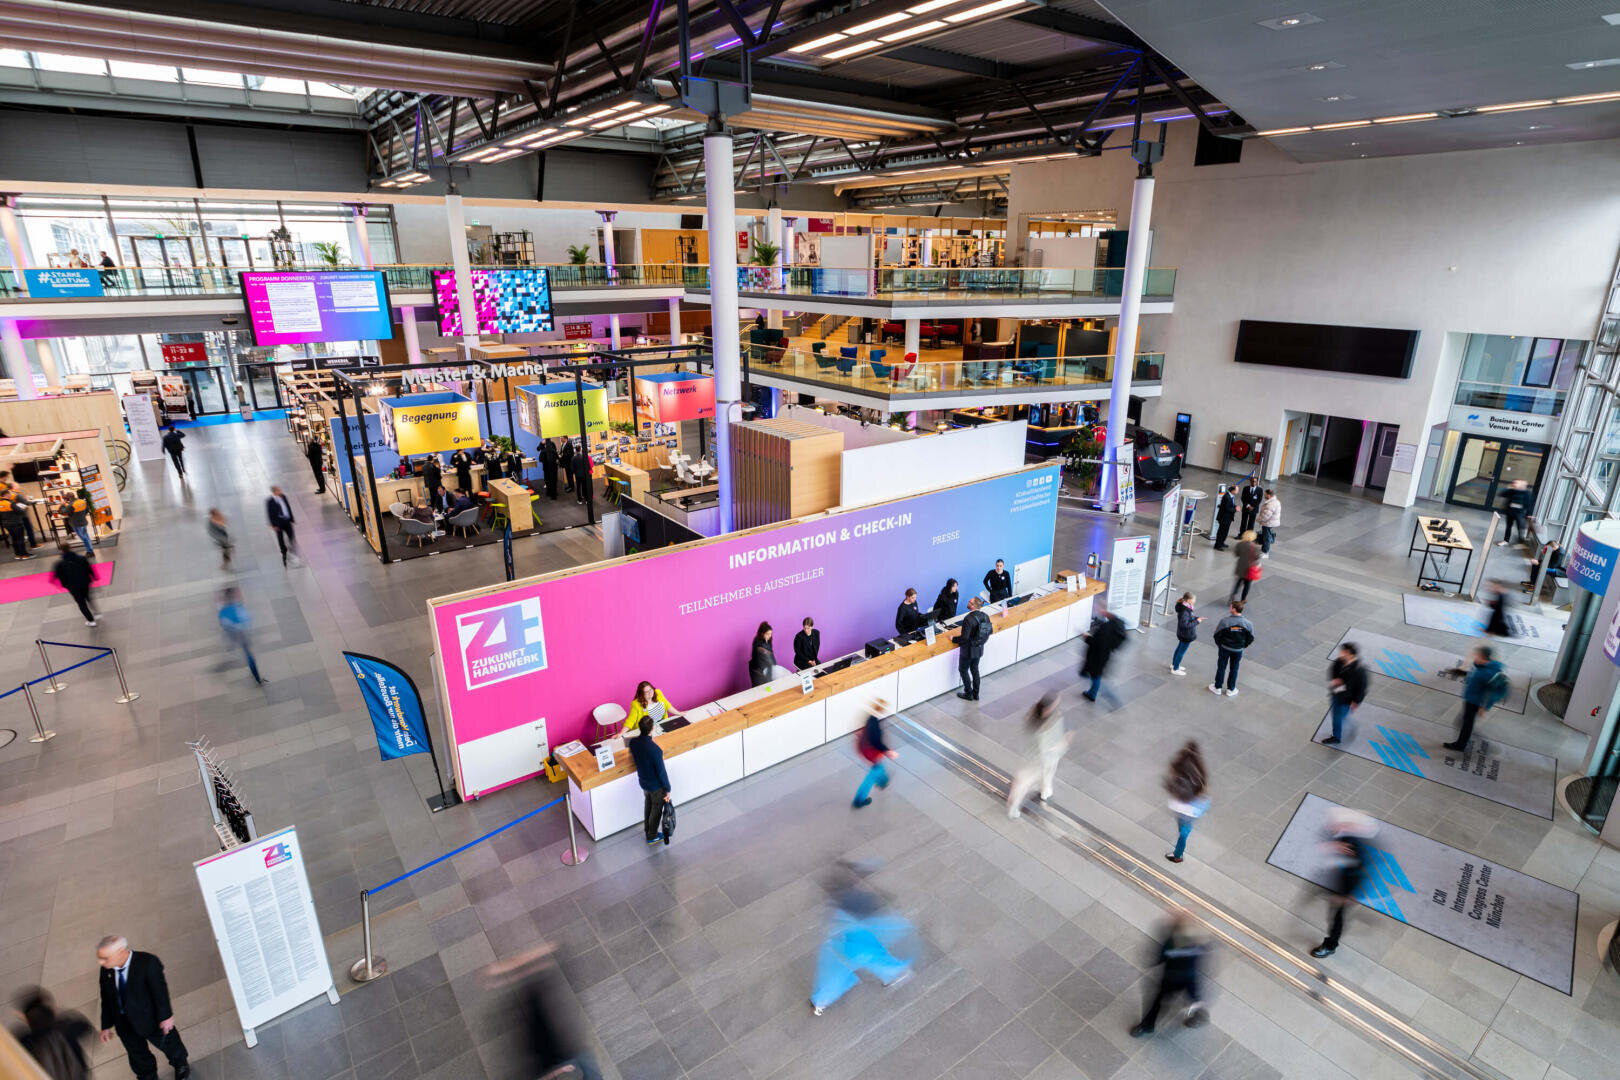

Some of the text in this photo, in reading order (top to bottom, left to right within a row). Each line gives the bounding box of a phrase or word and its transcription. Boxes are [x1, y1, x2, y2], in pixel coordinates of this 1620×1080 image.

[402, 361, 549, 384] Meister & Macher
[663, 385, 696, 395] Netzwerk
[401, 411, 458, 424] Begegnung
[1489, 423, 1510, 432] Venue
[1490, 416, 1519, 425] Business
[1521, 420, 1545, 428] Center
[729, 512, 912, 569] INFORMATION & CHECK-IN
[931, 530, 960, 546] PRESSE
[1580, 565, 1601, 581] 2026
[679, 567, 824, 616] TEILNEHMER & AUSSTELLER
[472, 648, 526, 669] ZUKUNFT
[472, 653, 539, 678] HANDWERK
[1444, 755, 1456, 768] ICM
[1486, 759, 1500, 782] München
[1432, 889, 1448, 906] ICM
[1449, 863, 1474, 914] Internationales
[1468, 864, 1493, 920] Congress Center
[1486, 894, 1505, 929] München
